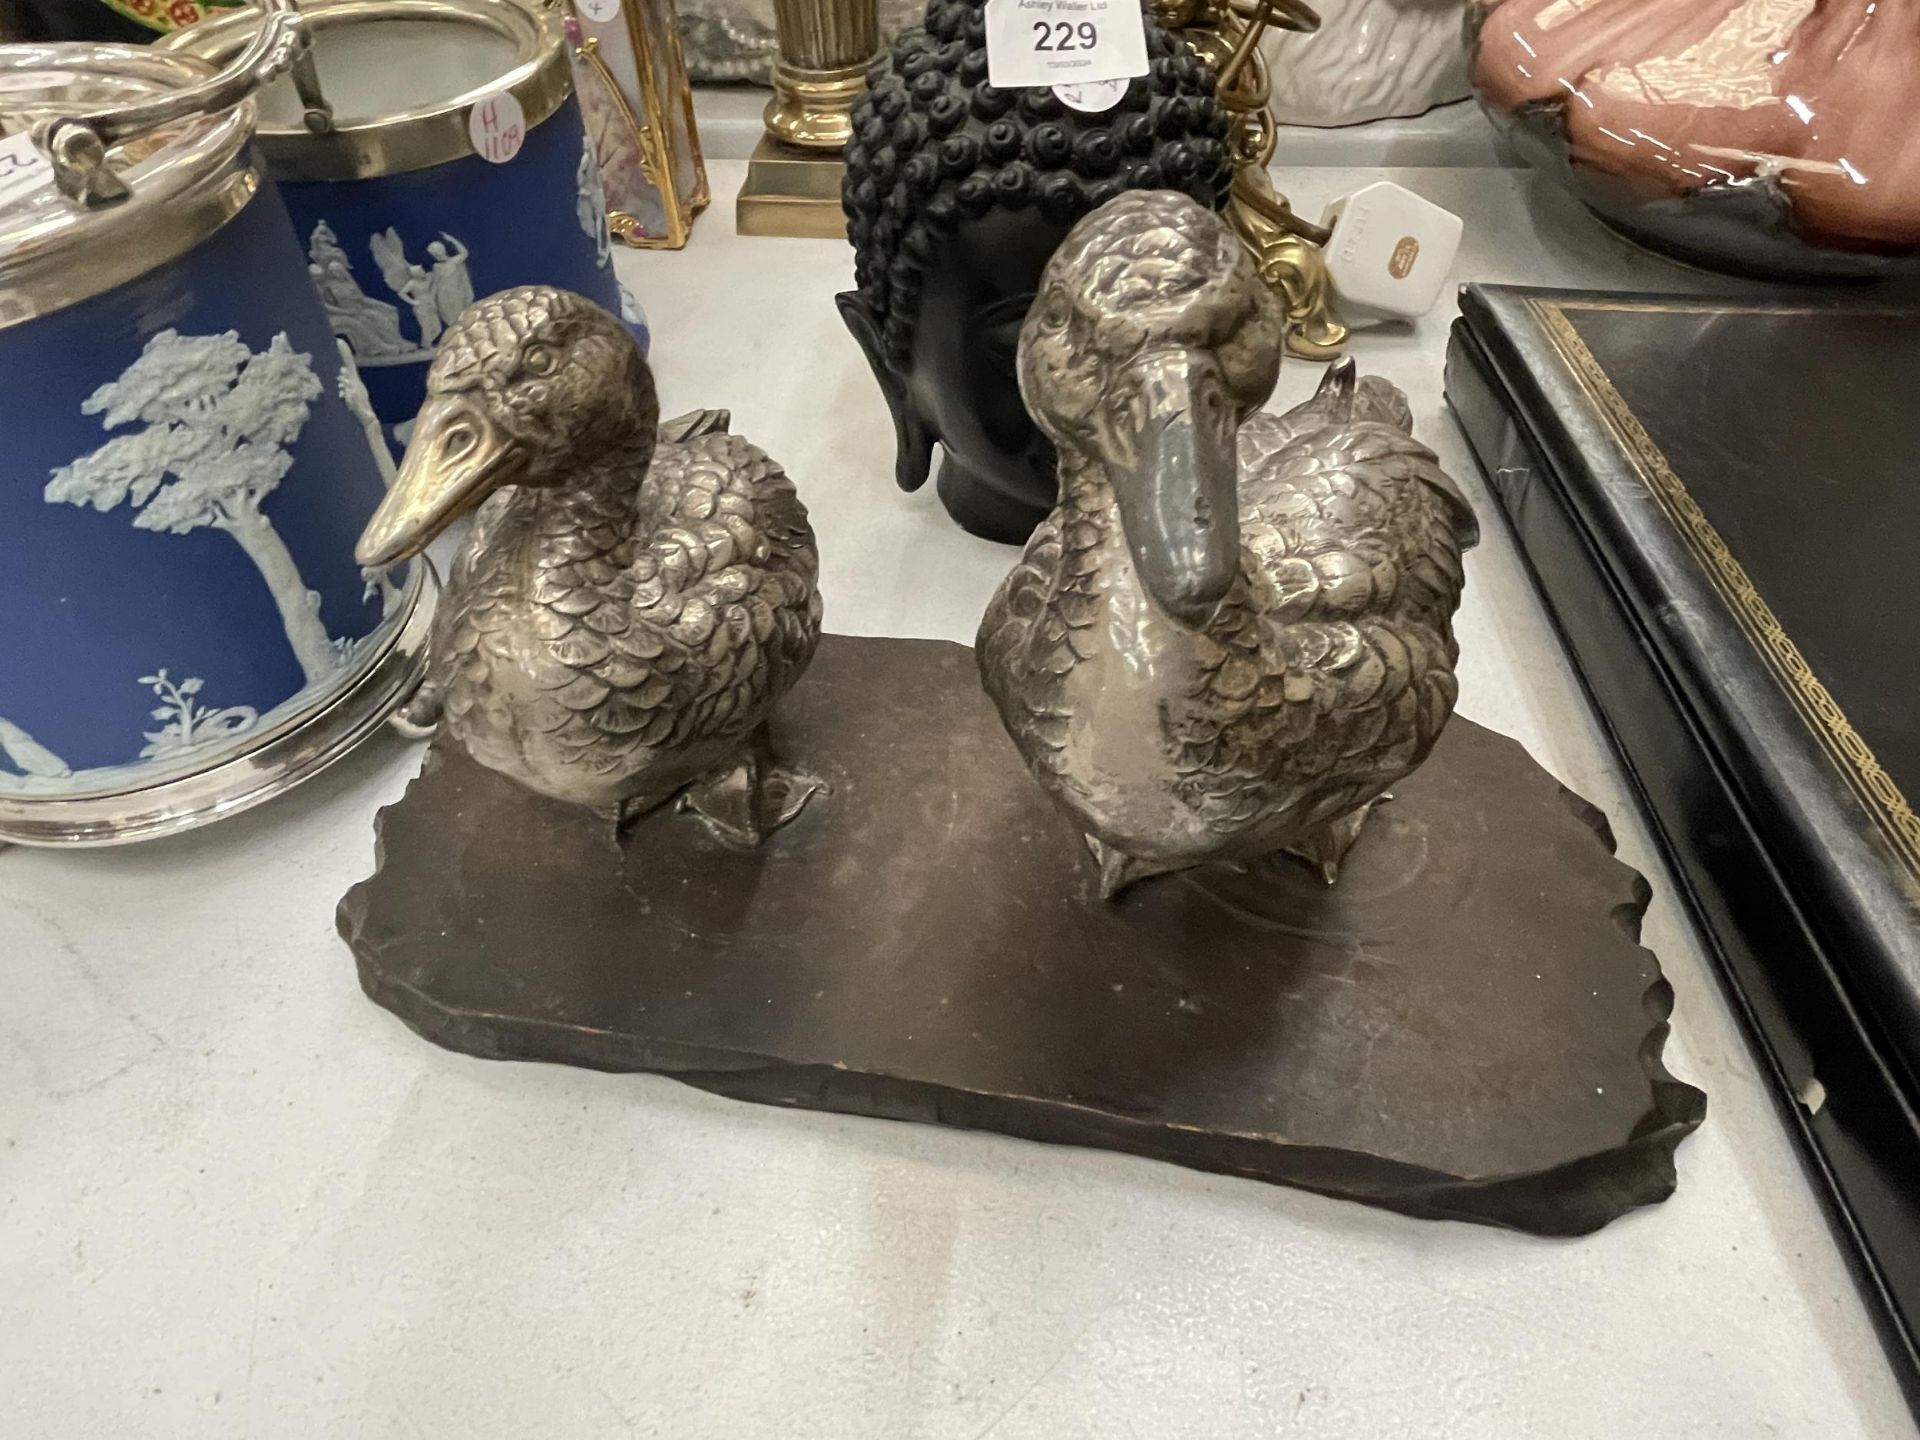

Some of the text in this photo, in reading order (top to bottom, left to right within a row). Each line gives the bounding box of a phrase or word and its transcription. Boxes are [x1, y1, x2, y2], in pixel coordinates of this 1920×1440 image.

[1018, 0, 1107, 12] Ashley Waller Ltd
[1033, 21, 1097, 51] 229
